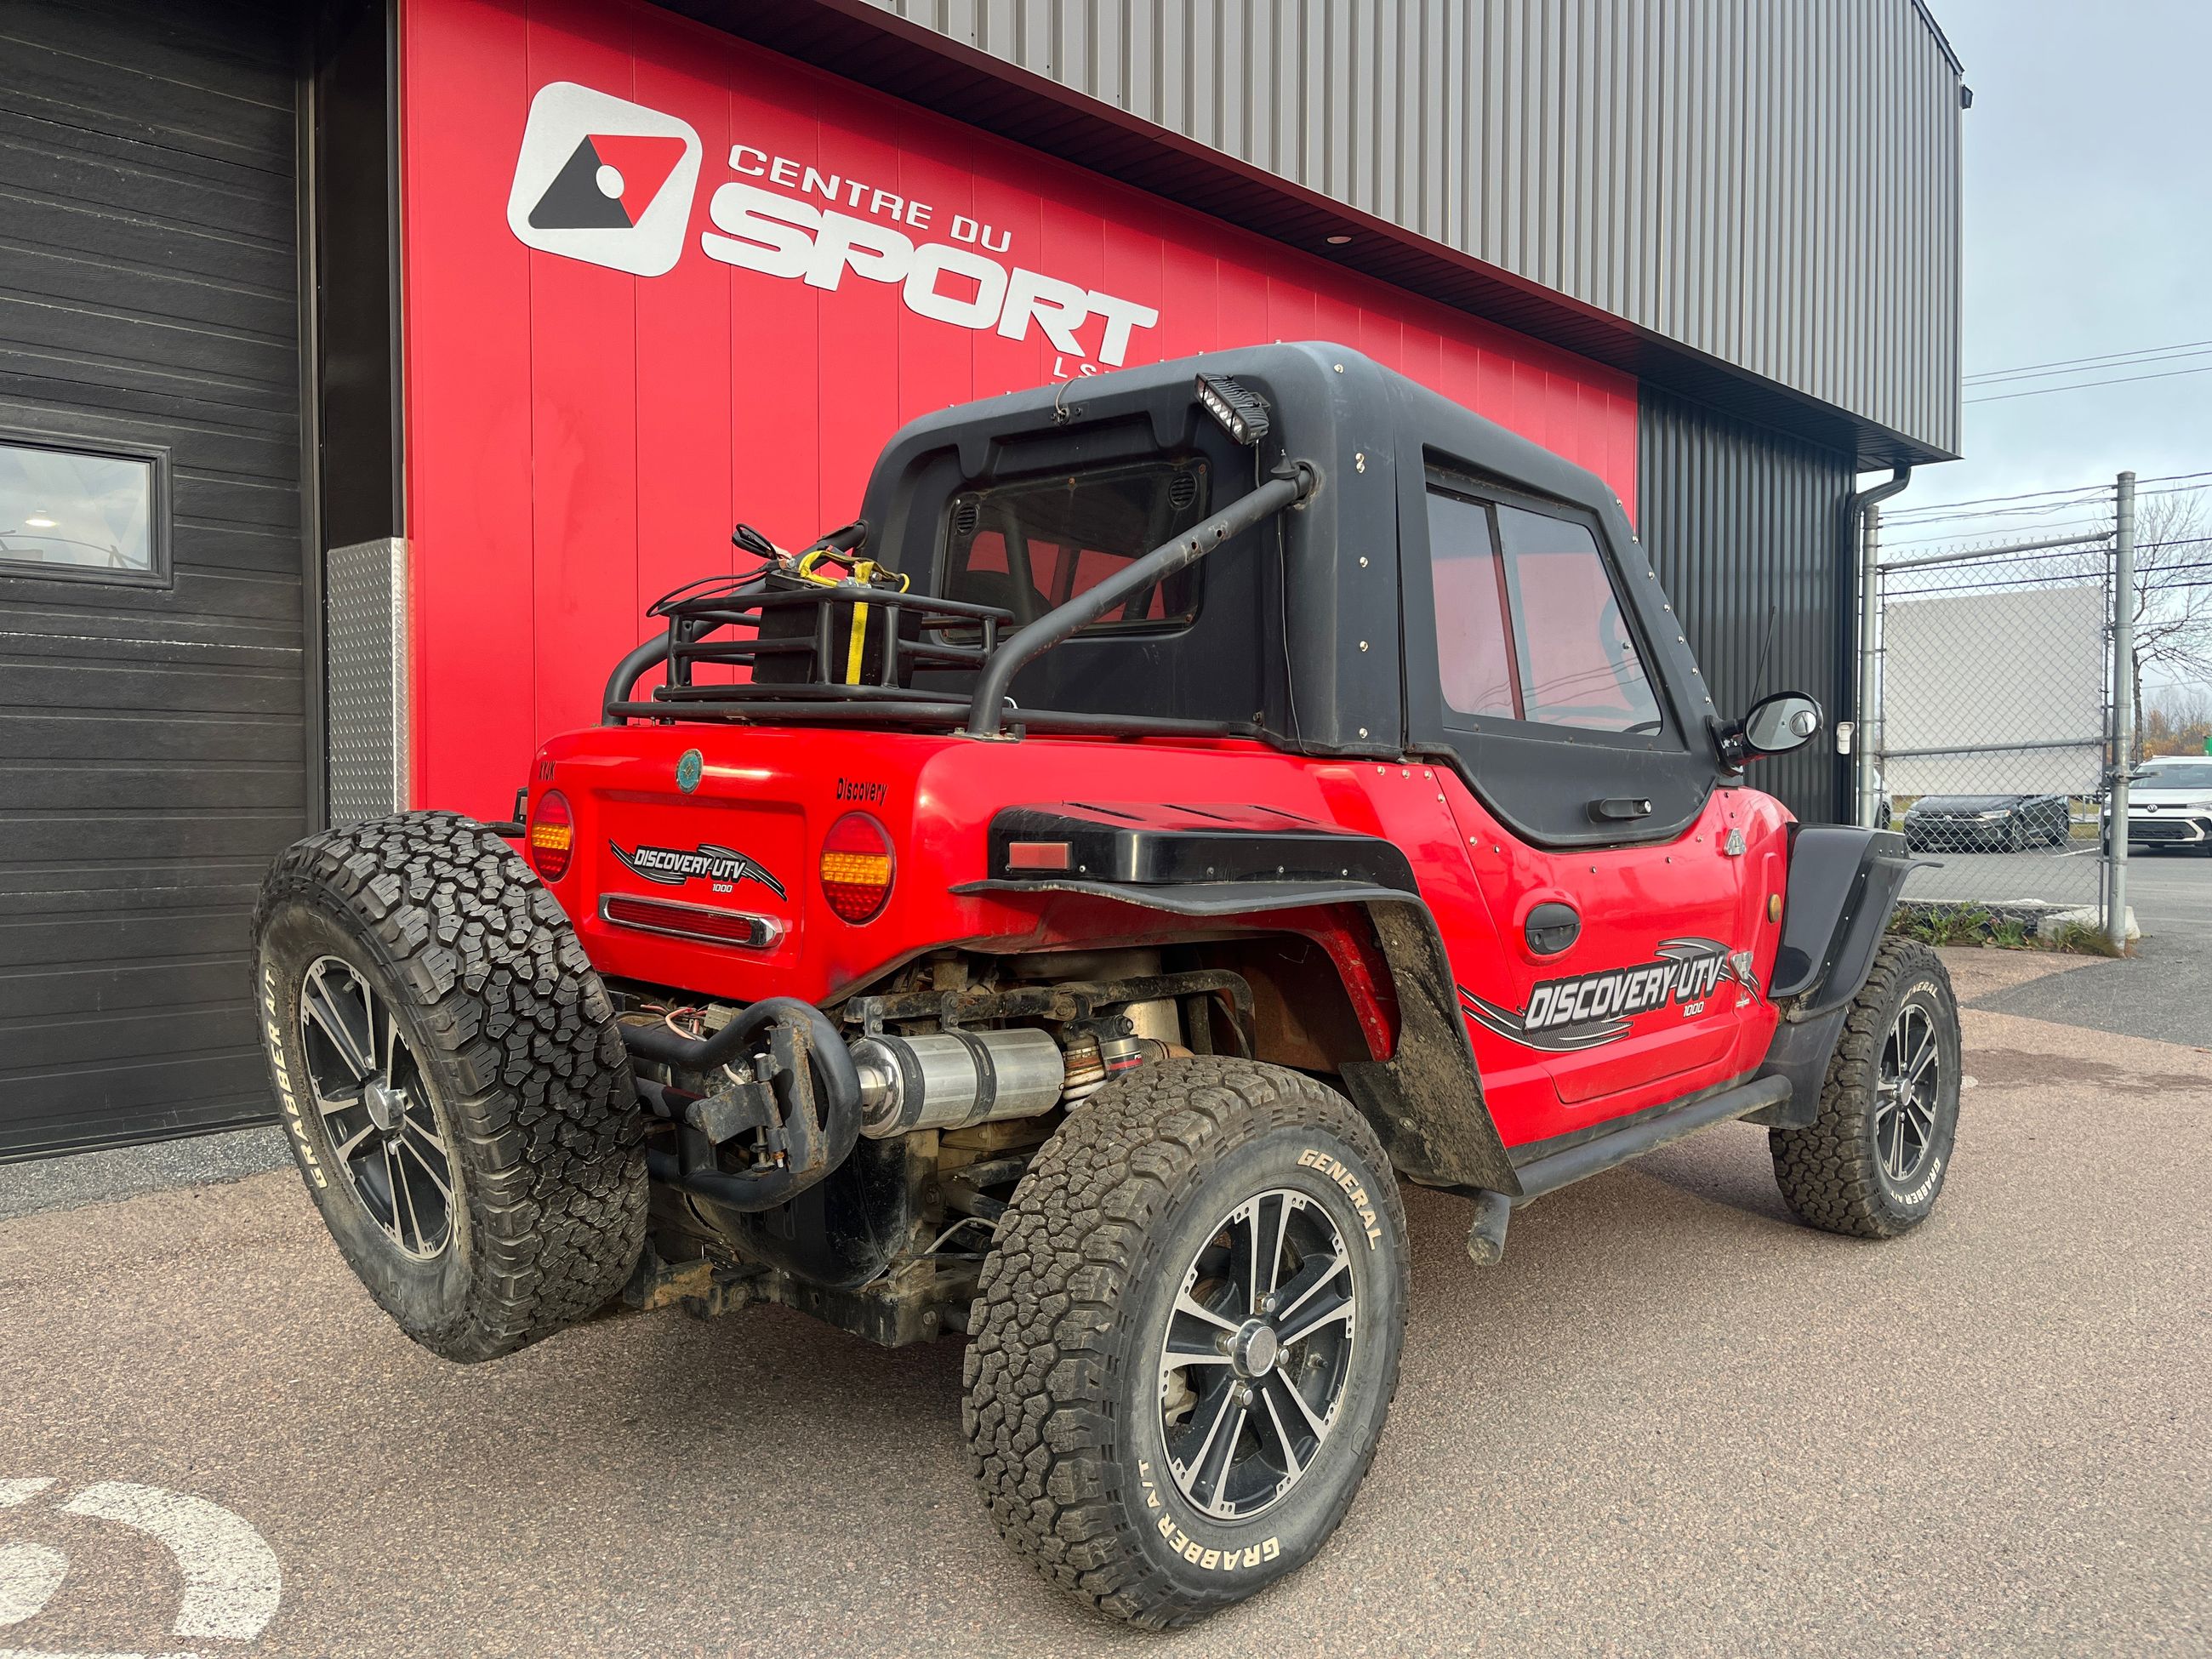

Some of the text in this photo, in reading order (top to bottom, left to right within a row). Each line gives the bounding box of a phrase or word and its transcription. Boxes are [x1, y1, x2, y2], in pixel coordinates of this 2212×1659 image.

[728, 145, 1012, 253] CENTRE DU
[700, 182, 1159, 367] SPORT
[837, 778, 887, 807] Discovery
[634, 849, 745, 879] DISCOVERY UTV
[712, 883, 733, 892] 1000
[1525, 955, 1725, 1029] DISCOVERY UTV
[1683, 1001, 1705, 1018] 1000
[265, 969, 328, 1189] GRABBER A/T
[1297, 1149, 1382, 1251] GENERAL
[1905, 1157, 1941, 1204] GRABBER
[1138, 1459, 1280, 1571] GRABBER A/T
